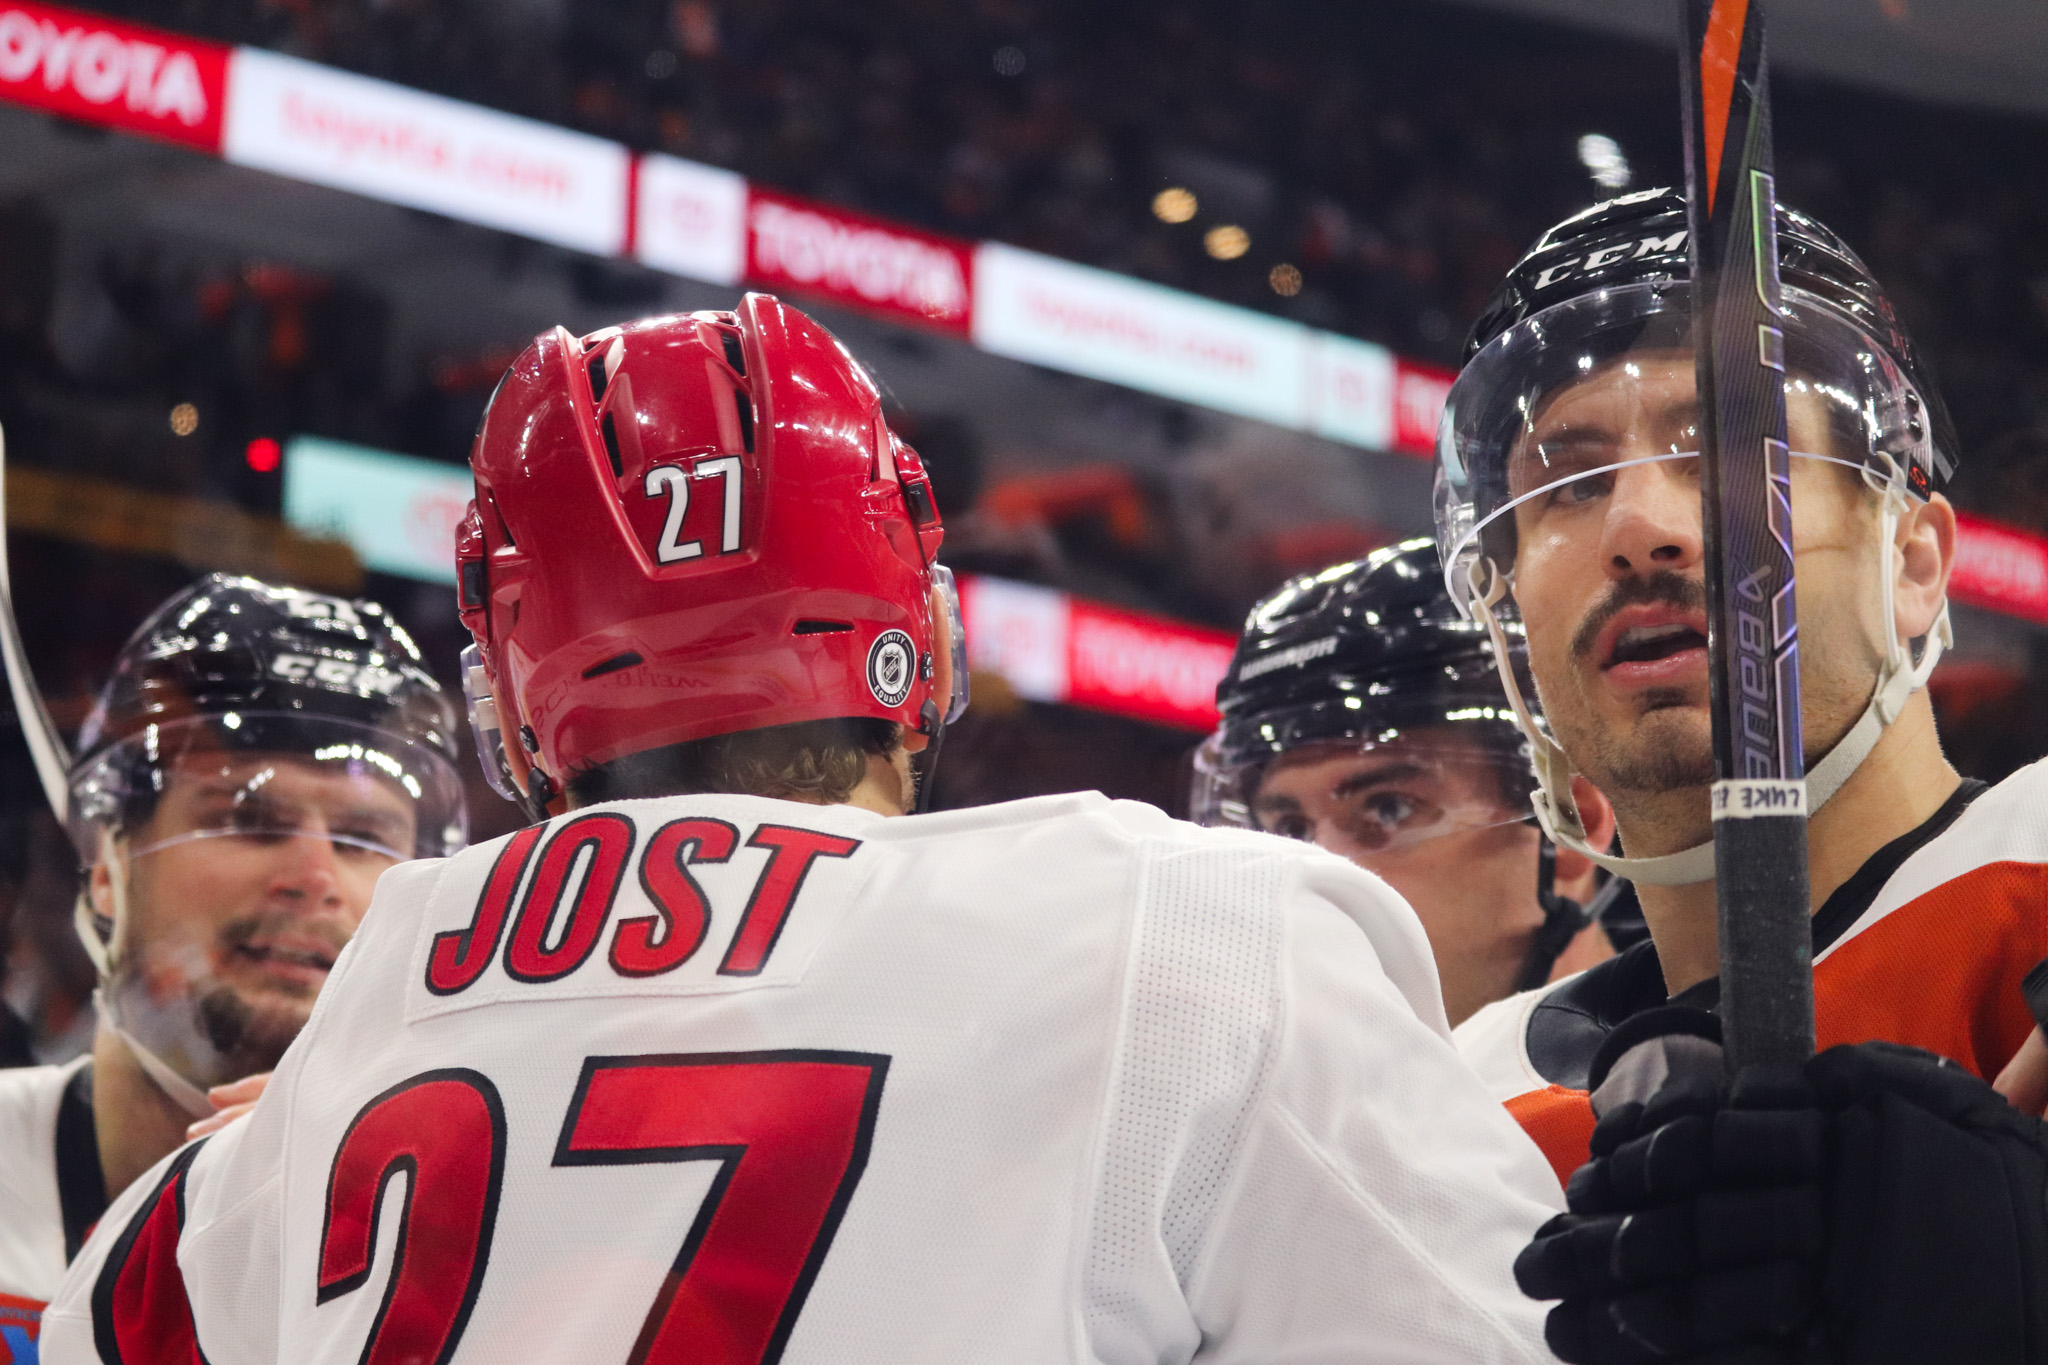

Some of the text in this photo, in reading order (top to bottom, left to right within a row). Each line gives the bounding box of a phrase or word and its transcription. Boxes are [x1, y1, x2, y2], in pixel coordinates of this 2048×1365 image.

[1534, 230, 1689, 290] CCM
[644, 455, 743, 567] 27
[881, 633, 906, 645] UNITY
[885, 659, 899, 679] NHL
[1074, 614, 1234, 710] TOYOT
[873, 684, 908, 704] EQUALITY
[1736, 609, 1773, 779] BAUE
[1739, 786, 1801, 809] LUKE
[425, 812, 863, 996] JOST
[316, 1048, 893, 1365] 27
